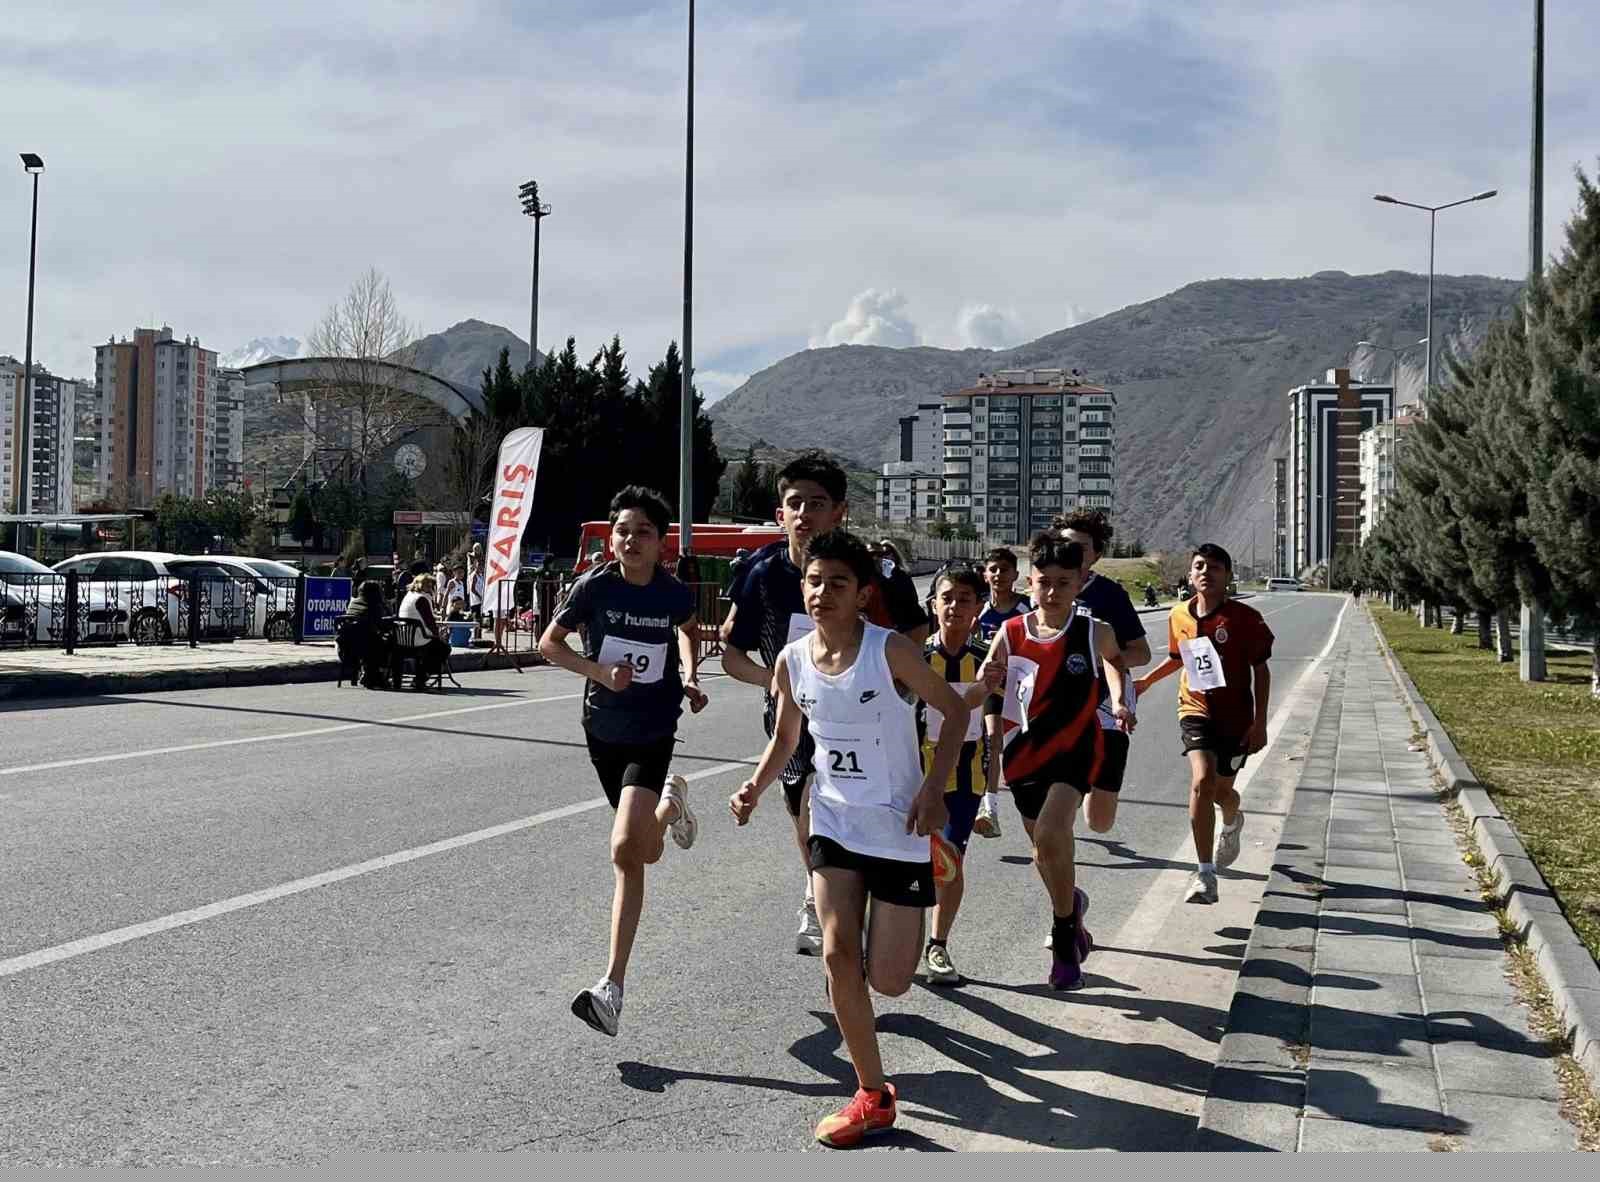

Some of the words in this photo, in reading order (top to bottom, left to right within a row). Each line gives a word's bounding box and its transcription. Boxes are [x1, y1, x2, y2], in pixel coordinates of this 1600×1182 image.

[487, 463, 534, 586] VARIŞ
[307, 599, 348, 612] OTOPARK
[624, 611, 670, 628] hummel
[624, 653, 650, 674] 19
[1194, 654, 1213, 671] 25
[828, 749, 863, 773] 21
